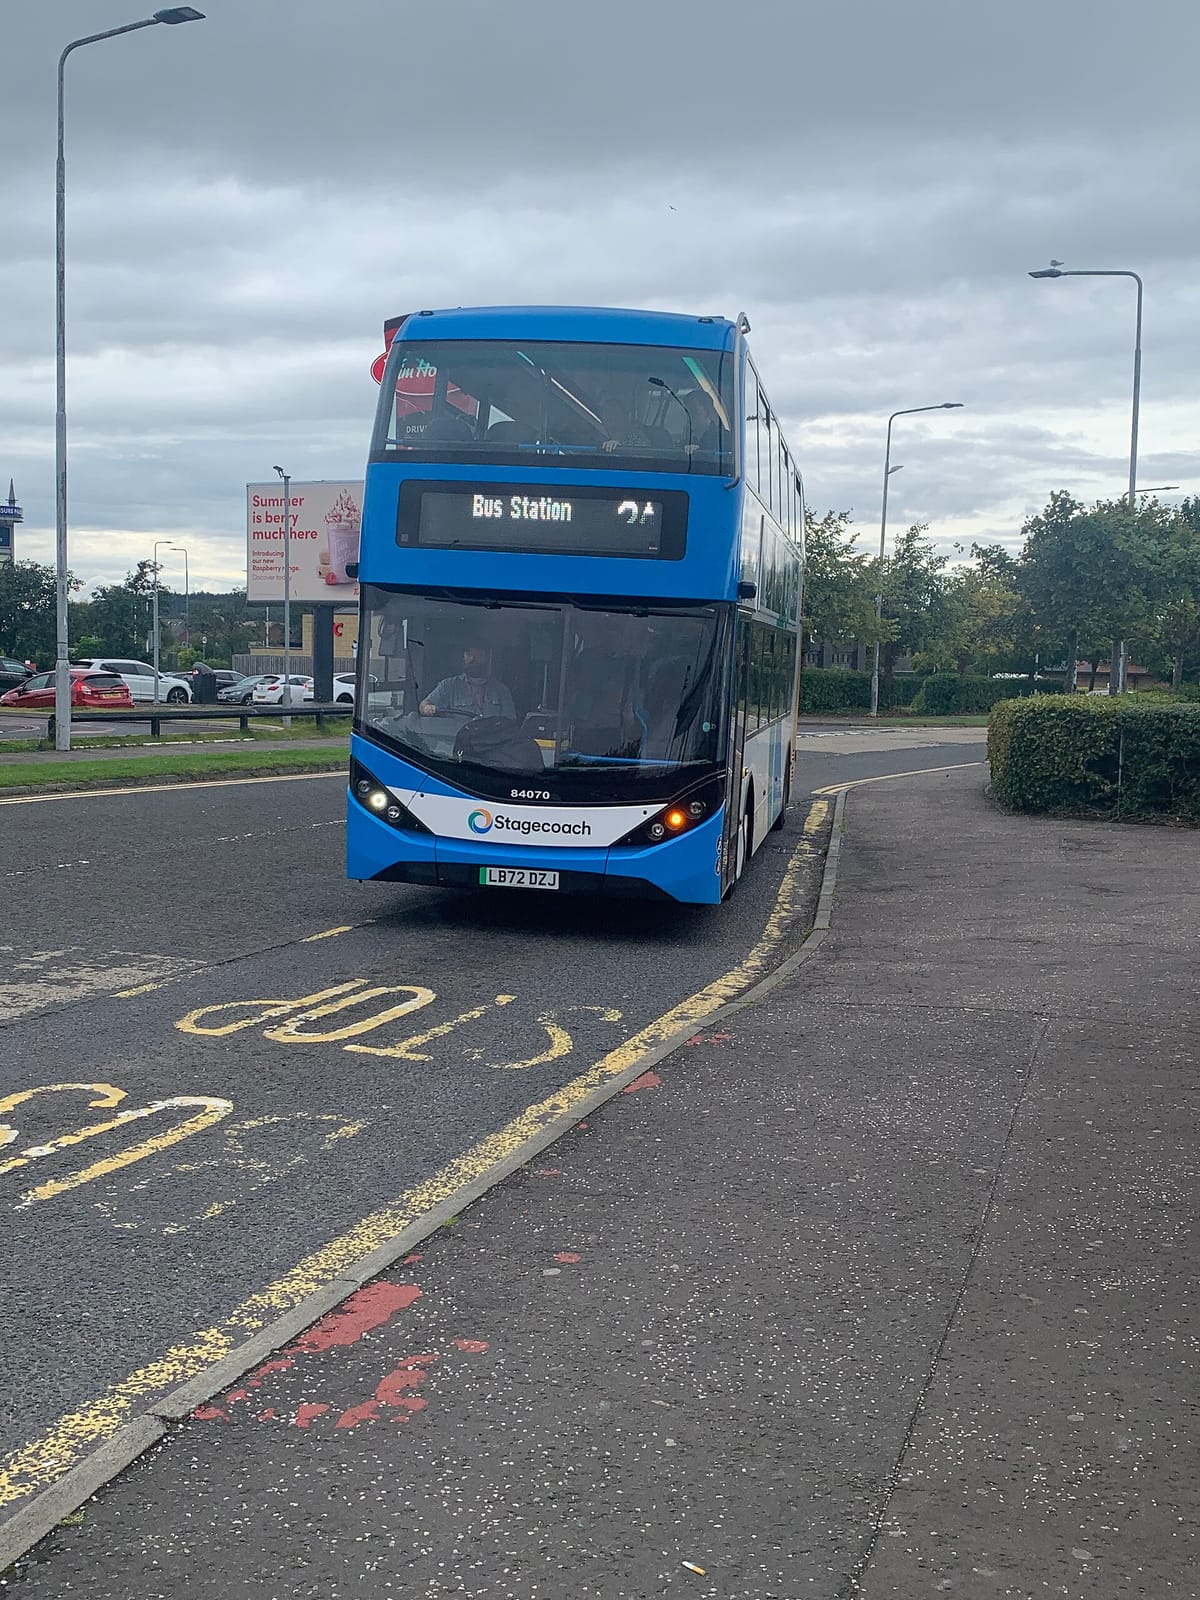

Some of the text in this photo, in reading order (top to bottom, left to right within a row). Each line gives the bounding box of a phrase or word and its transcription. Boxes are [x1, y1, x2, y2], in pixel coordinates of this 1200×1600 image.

[472, 494, 503, 518] Bus
[510, 496, 573, 521] Station
[252, 511, 262, 523] is
[252, 527, 318, 540] much here
[252, 550, 285, 558] Introducing
[510, 789, 551, 800] 84070
[494, 815, 591, 835] Stagecoach
[488, 869, 557, 887] LB72 DZJ
